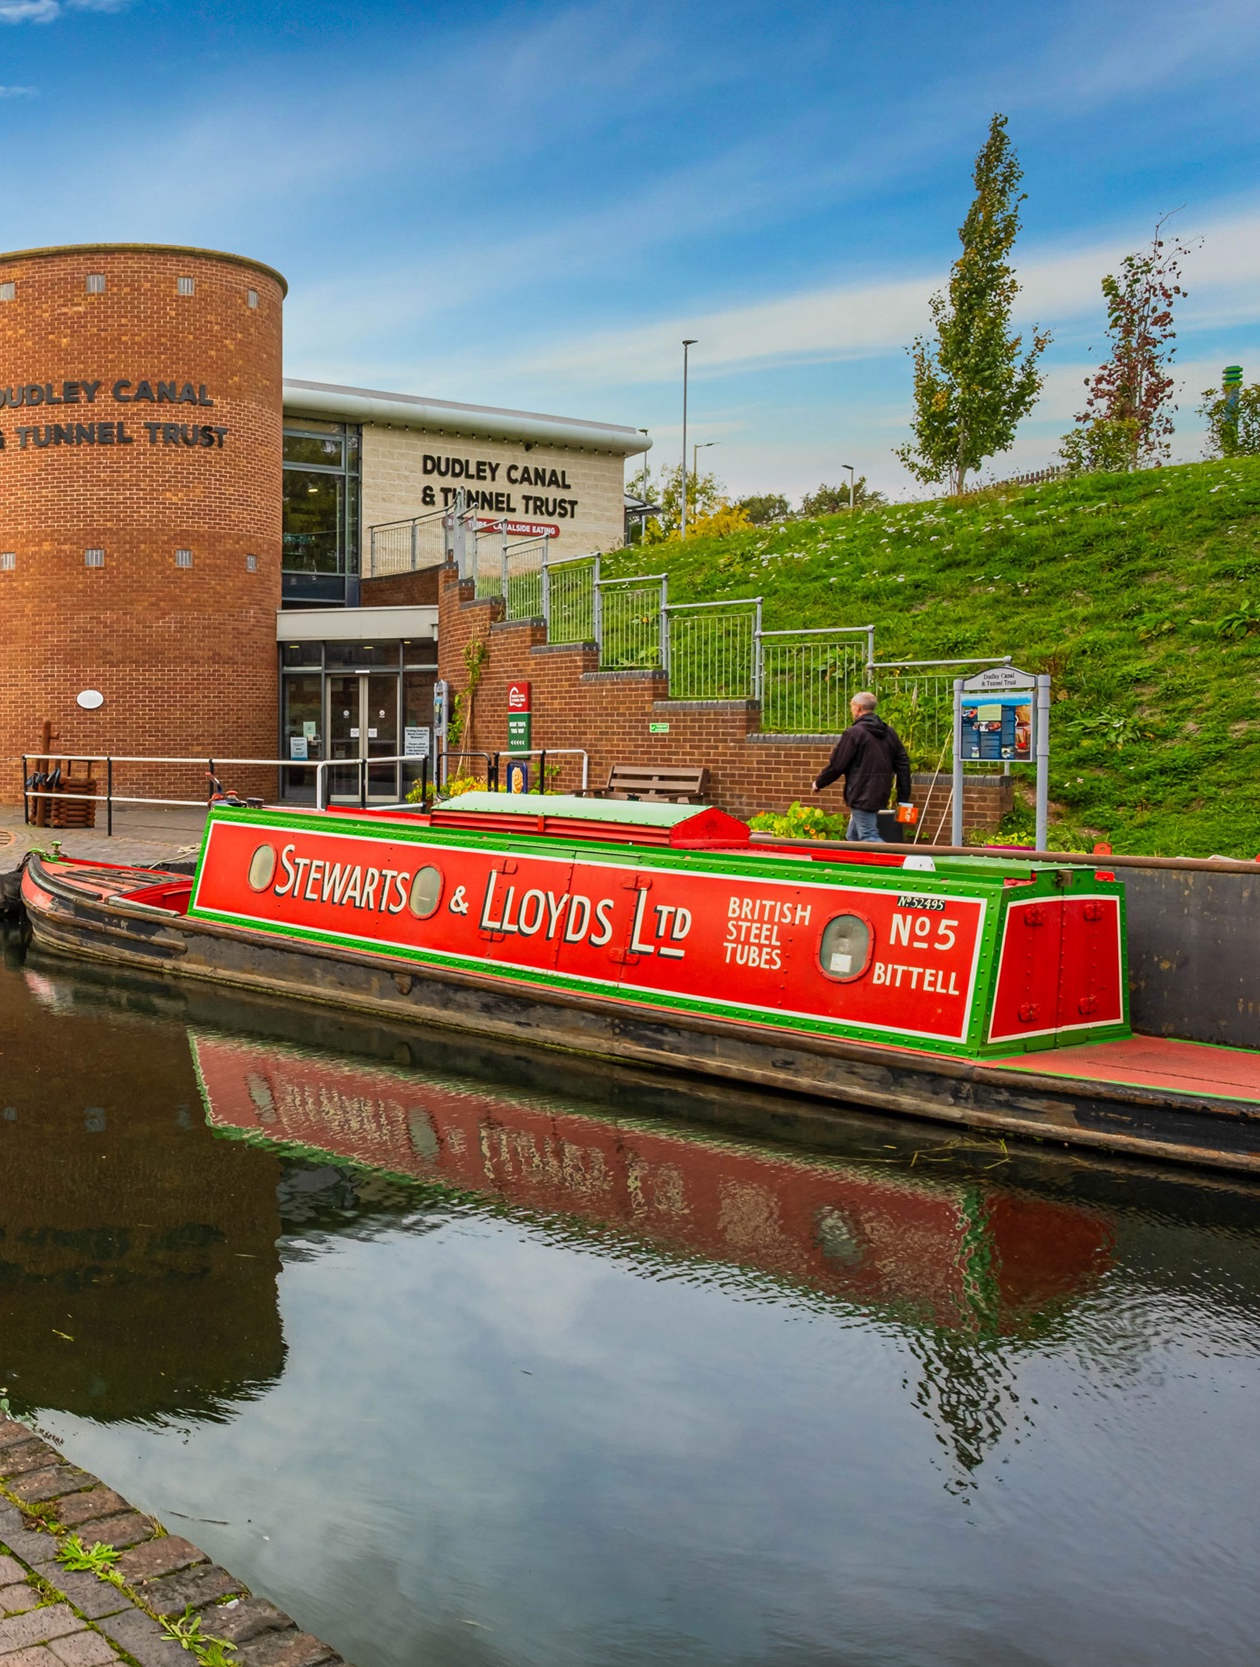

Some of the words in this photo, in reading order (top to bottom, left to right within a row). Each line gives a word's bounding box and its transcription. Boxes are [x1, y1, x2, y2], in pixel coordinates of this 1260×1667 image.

[113, 380, 214, 406] CANAL
[15, 422, 133, 447] TUNNEL
[144, 421, 228, 448] TRUST
[423, 454, 500, 482] DUDLEY
[507, 464, 571, 489] CANAL
[422, 485, 435, 506] &
[522, 495, 578, 519] TRUST
[532, 526, 556, 535] EATING
[275, 844, 411, 914] STEWARTS
[449, 886, 469, 914] &
[480, 869, 615, 946] LLOYDS
[629, 887, 692, 958] LTD
[727, 896, 812, 926] BRITISH
[727, 920, 781, 946] STEEL
[723, 942, 781, 970] TUBES
[873, 962, 960, 995] BITTELL
